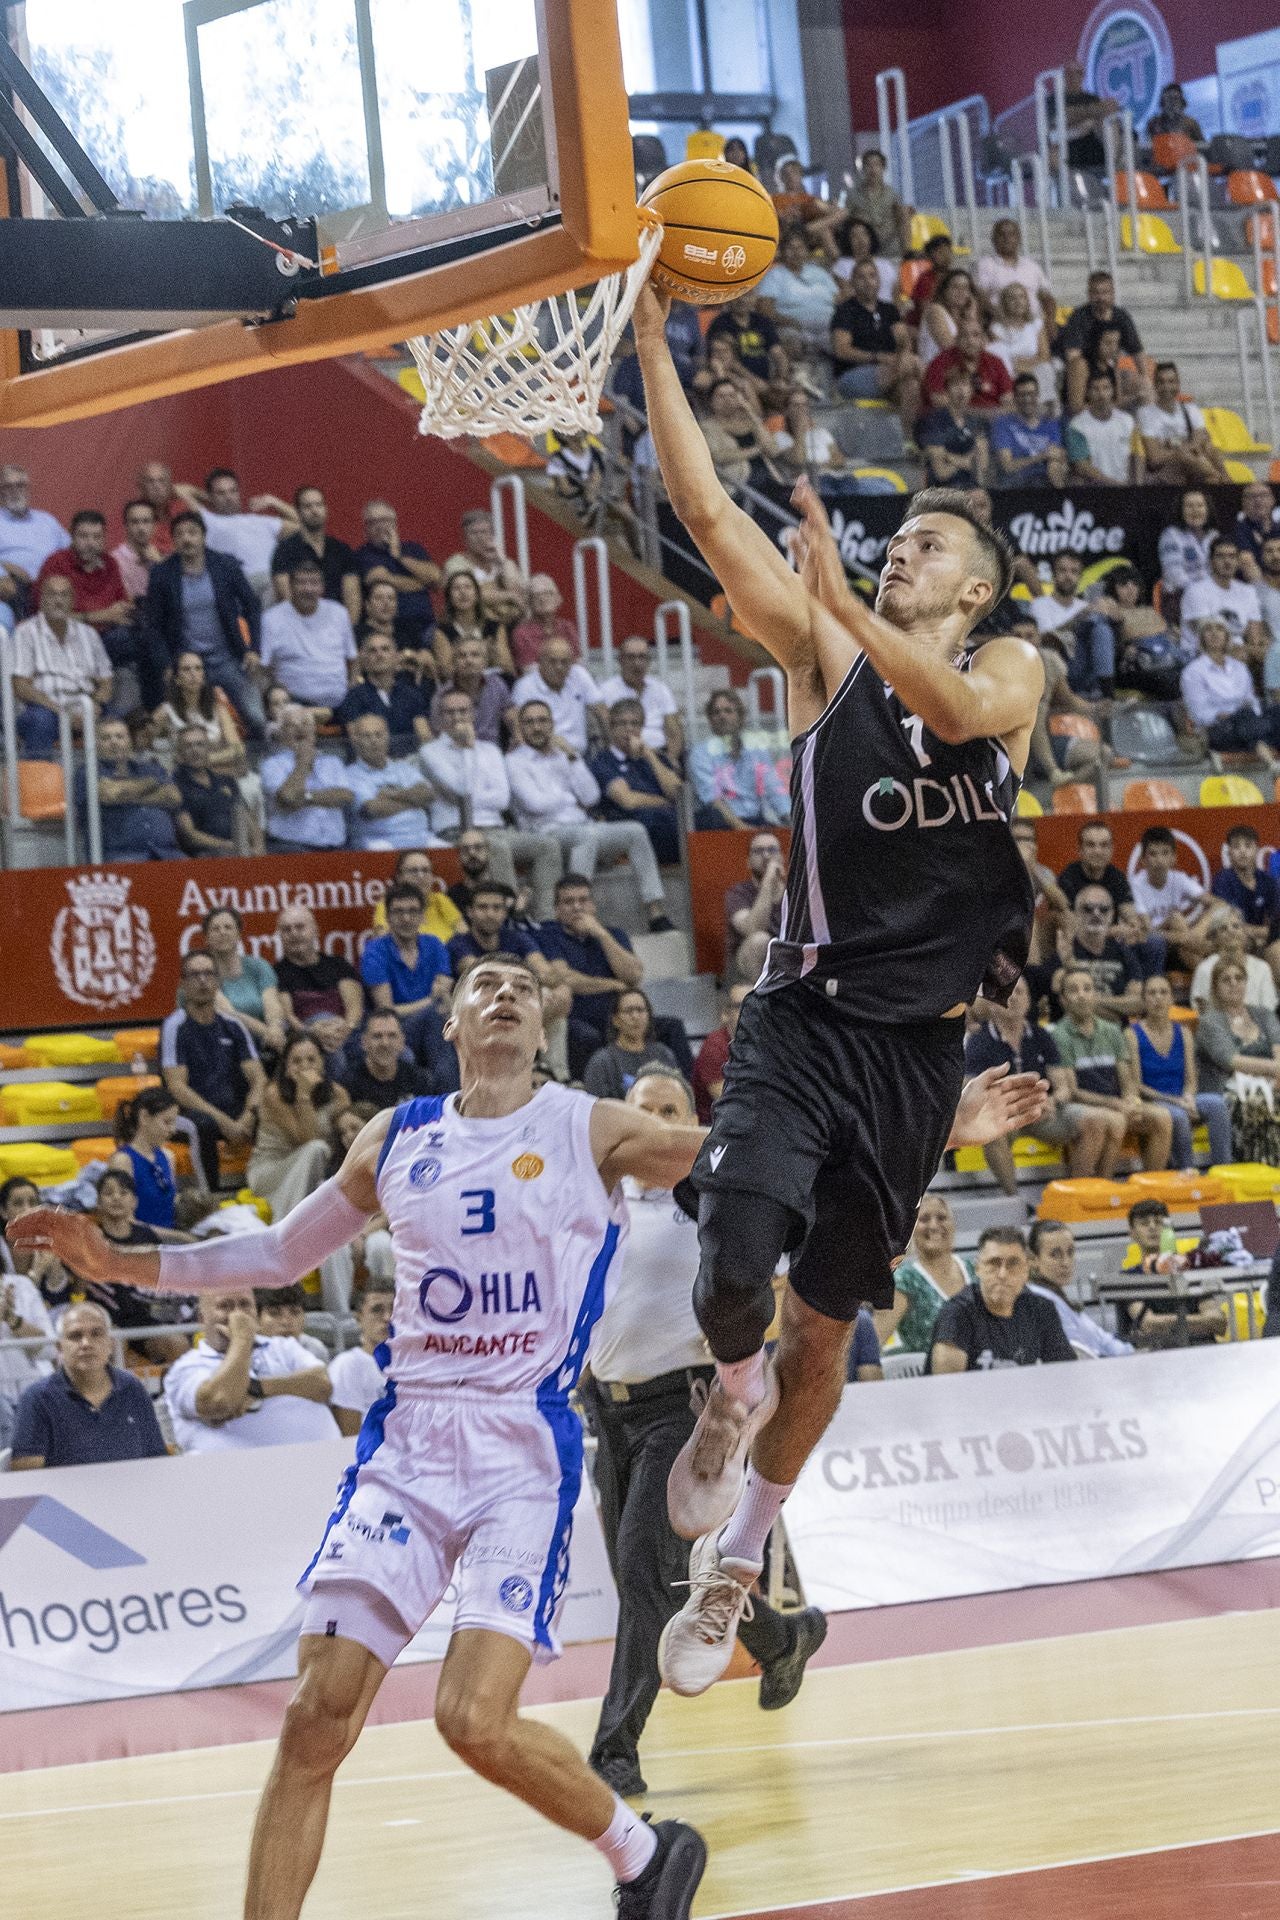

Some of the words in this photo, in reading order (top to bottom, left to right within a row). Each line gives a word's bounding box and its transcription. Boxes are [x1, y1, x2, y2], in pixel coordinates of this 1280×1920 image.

[684, 244, 718, 261] FEB
[459, 1187, 496, 1235] 3
[480, 1270, 542, 1315] HLA
[423, 1331, 538, 1357] ALICANTE
[822, 1440, 958, 1492] CASA
[961, 1409, 1149, 1476] TOMÁS
[0, 1585, 247, 1653] hogares
